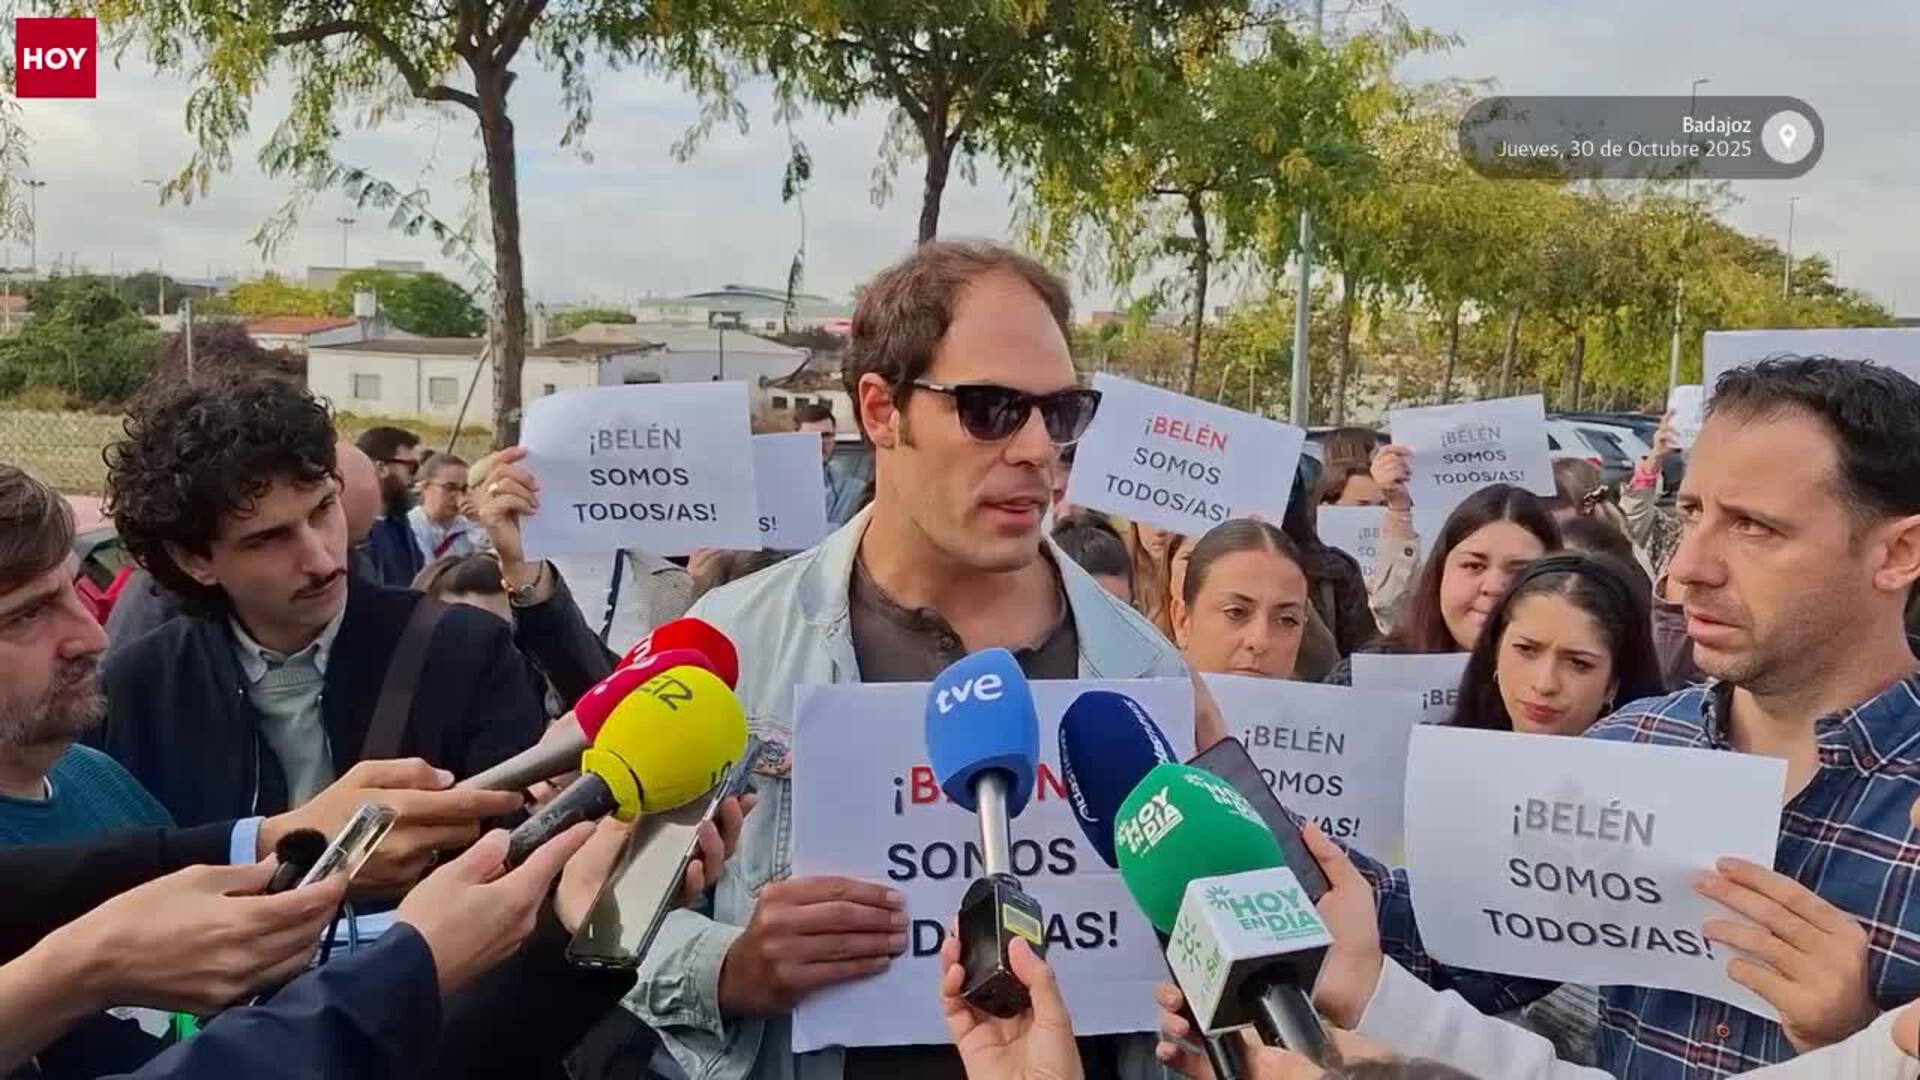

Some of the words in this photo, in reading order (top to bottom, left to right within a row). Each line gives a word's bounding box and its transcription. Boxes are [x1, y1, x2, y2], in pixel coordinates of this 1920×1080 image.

[589, 423, 682, 454] ¡BELÉN
[1144, 416, 1229, 452] ¡BELÉN
[1133, 447, 1222, 485] SOMOS
[1442, 449, 1507, 465] SOMOS
[590, 467, 689, 486] SOMOS
[1433, 470, 1525, 486] TODOS/AS!
[572, 502, 718, 523] TODOS/AS!
[1105, 474, 1232, 523] TODOS/AS!
[935, 673, 1004, 715] tve
[1244, 725, 1345, 755] ¡BELÉN
[1258, 768, 1344, 797] OMOS
[1512, 799, 1656, 847] ¡BELÉN
[1508, 858, 1662, 904] SOMOS
[1229, 888, 1299, 918] HOY
[1240, 917, 1270, 930] EN
[1482, 909, 1716, 960] TODOS/AS!
